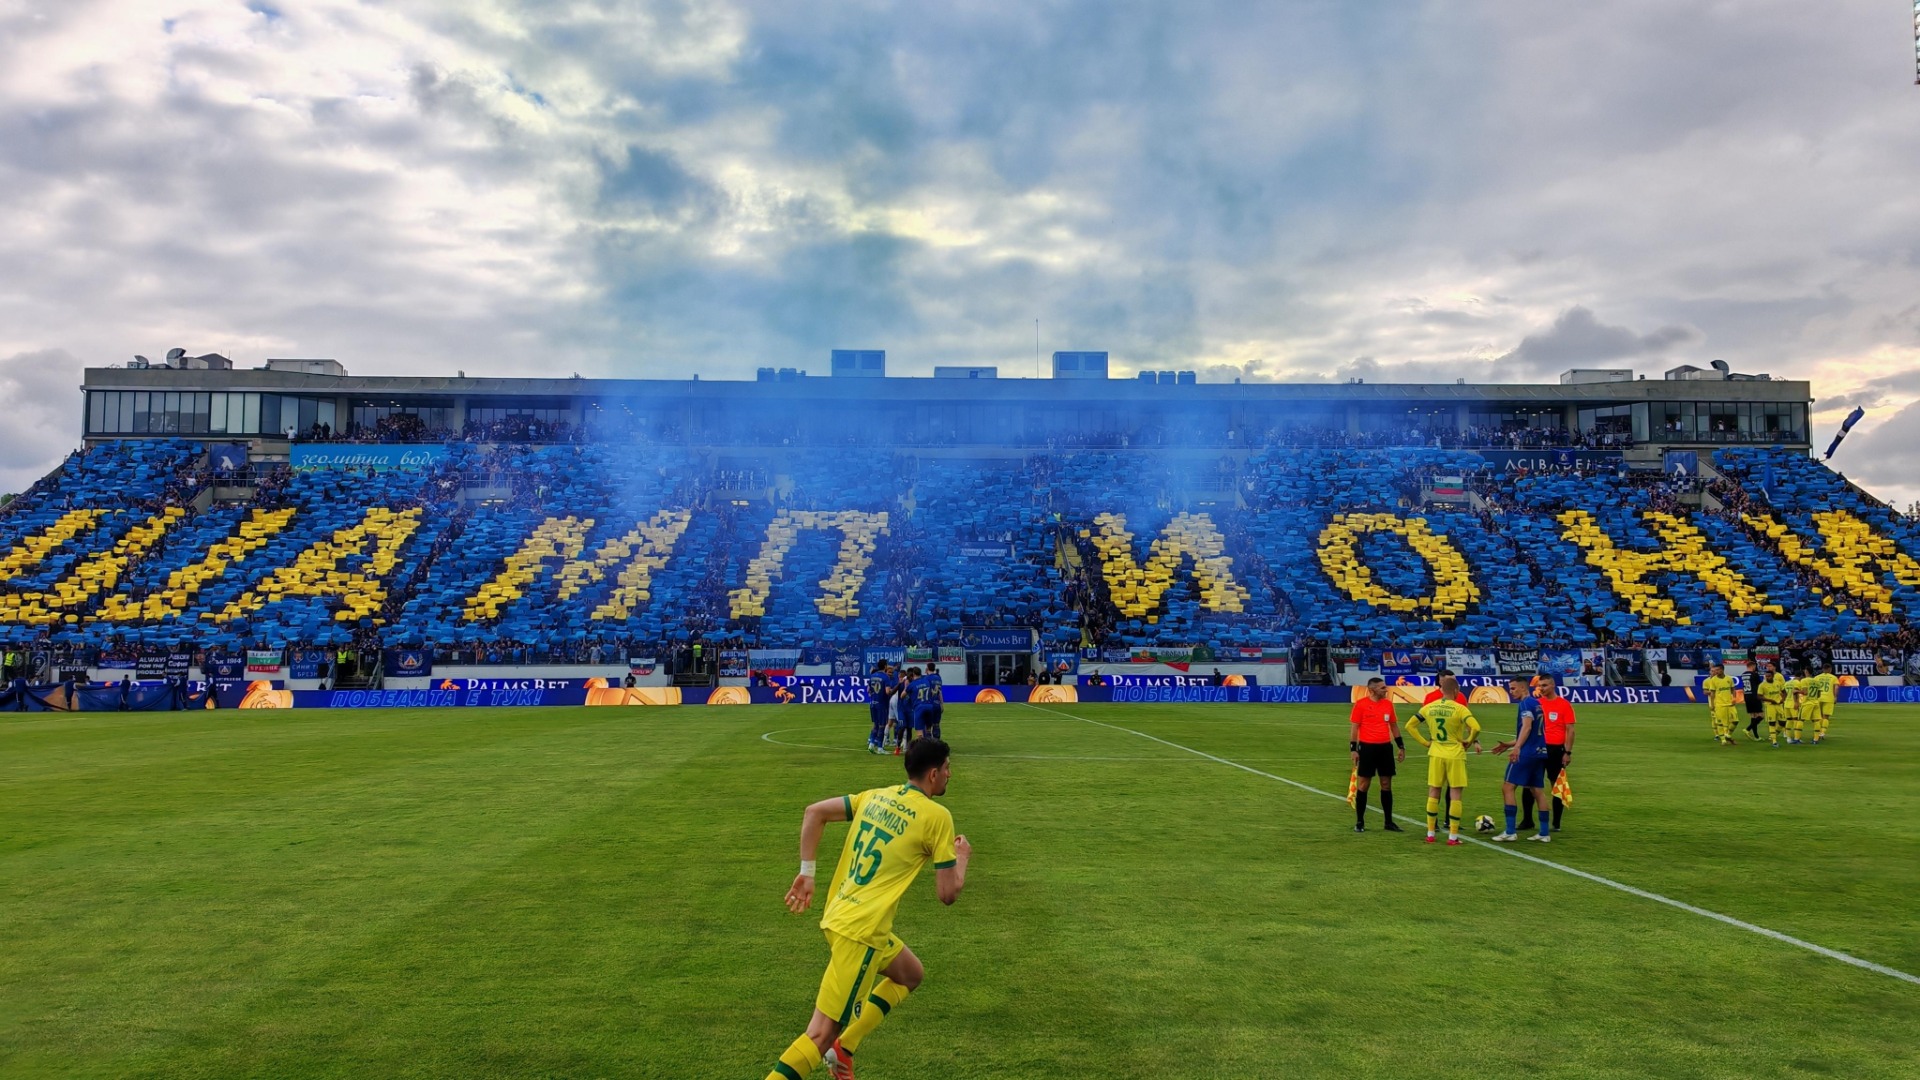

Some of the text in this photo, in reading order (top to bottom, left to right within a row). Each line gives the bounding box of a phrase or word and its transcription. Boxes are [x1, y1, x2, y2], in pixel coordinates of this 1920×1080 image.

[295, 453, 390, 469] зеолитна
[1505, 458, 1592, 470] ACIBAE
[981, 635, 1028, 645] PALMS BET
[866, 651, 904, 664] ВЕТЕРАНИ
[1831, 649, 1873, 660] ULTRAS
[1834, 664, 1874, 675] LEVSKI
[331, 689, 544, 707] ПОБЕДАТА Е ТУК!
[801, 685, 865, 703] PALMS
[1112, 686, 1310, 703] ПОБЕДАТА Е ТУК!
[1557, 686, 1660, 704] PALMS BET
[1848, 686, 1878, 703] ДО
[1436, 717, 1448, 743] 3
[872, 793, 917, 819] VIVACOM
[862, 801, 908, 836] NACHMIAS
[848, 820, 895, 887] 55
